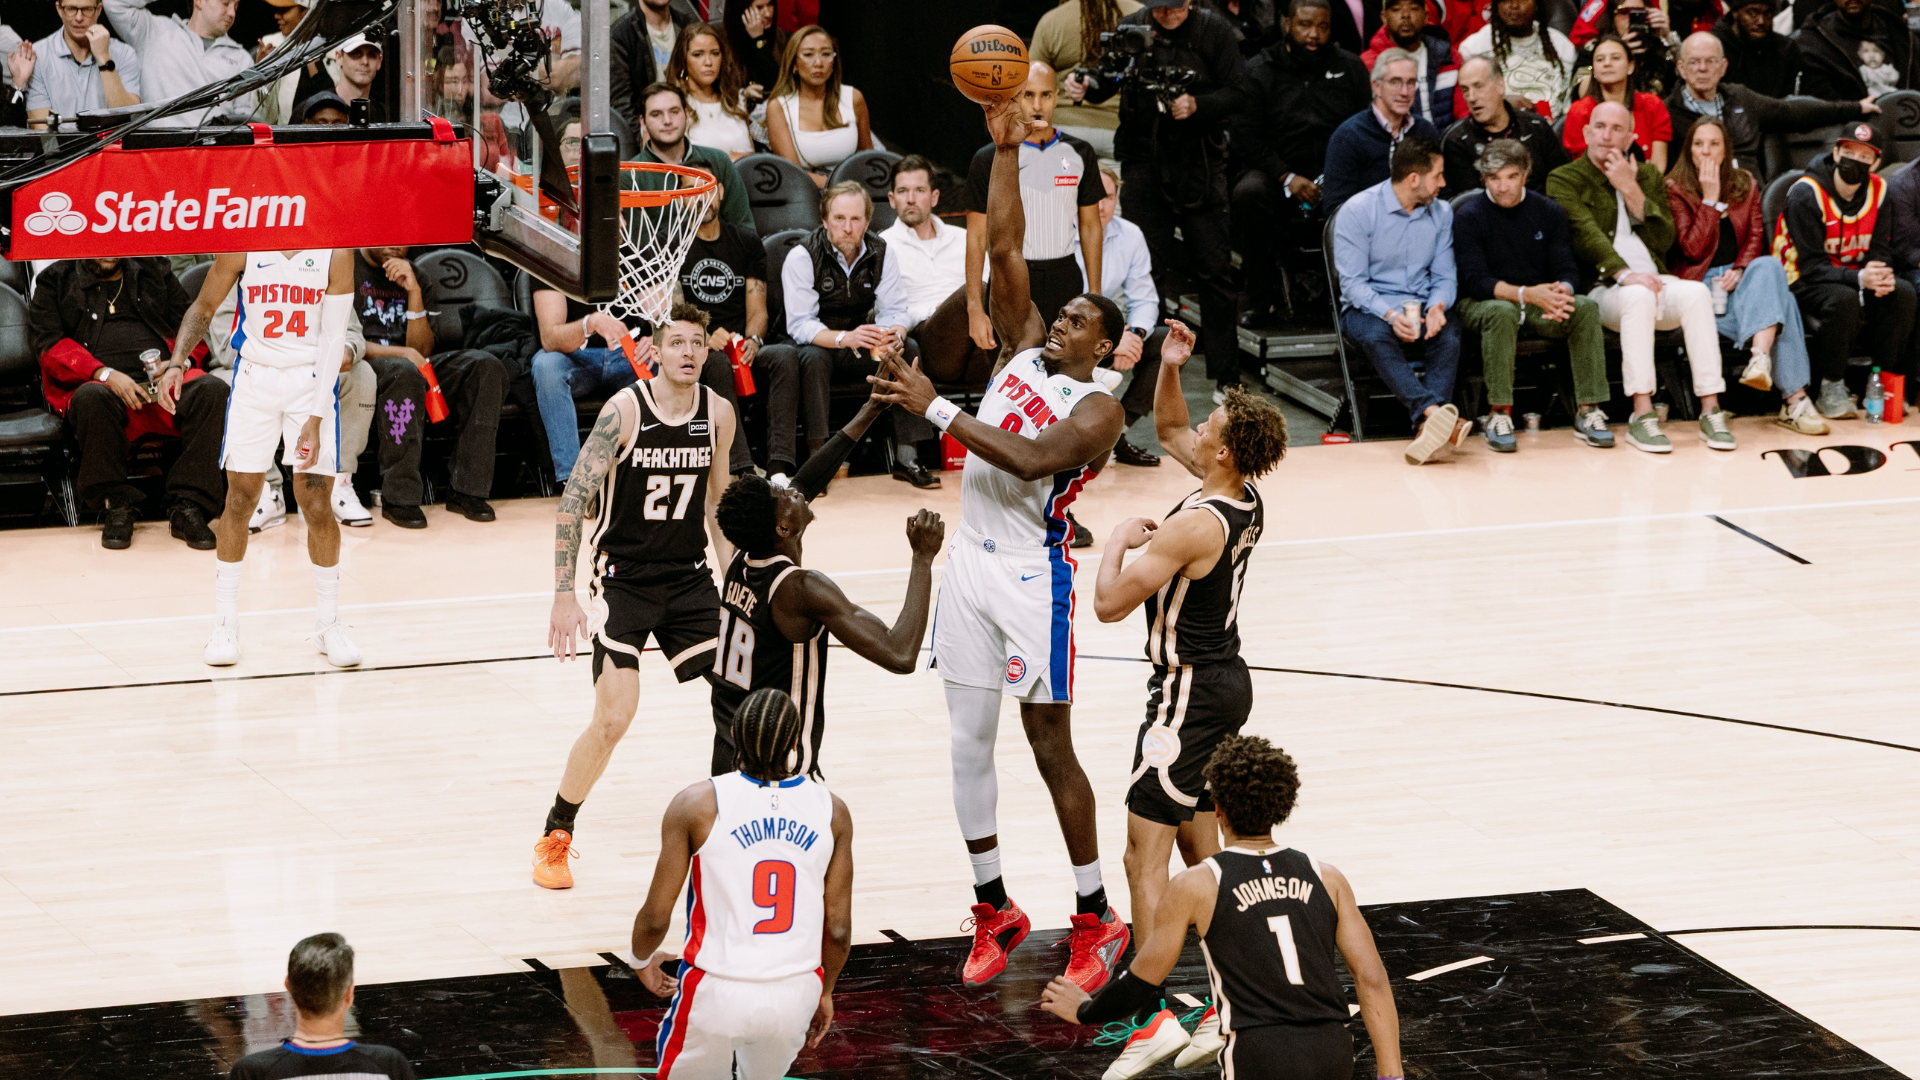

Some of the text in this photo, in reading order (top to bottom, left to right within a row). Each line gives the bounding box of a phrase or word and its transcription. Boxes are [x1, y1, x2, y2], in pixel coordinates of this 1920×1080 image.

[970, 39, 1021, 57] Wilson
[248, 284, 325, 305] PISTONS
[698, 275, 726, 287] CNS
[263, 310, 309, 338] 24
[691, 424, 707, 432] paze
[632, 446, 712, 468] PEACHTREE
[648, 474, 699, 520] 27
[1231, 525, 1260, 566] DANIELS
[712, 606, 755, 691] 18
[730, 817, 818, 852] THOMPSON
[751, 859, 796, 934] 9
[1231, 876, 1313, 912] JOHNSON
[1266, 914, 1304, 985] 1
